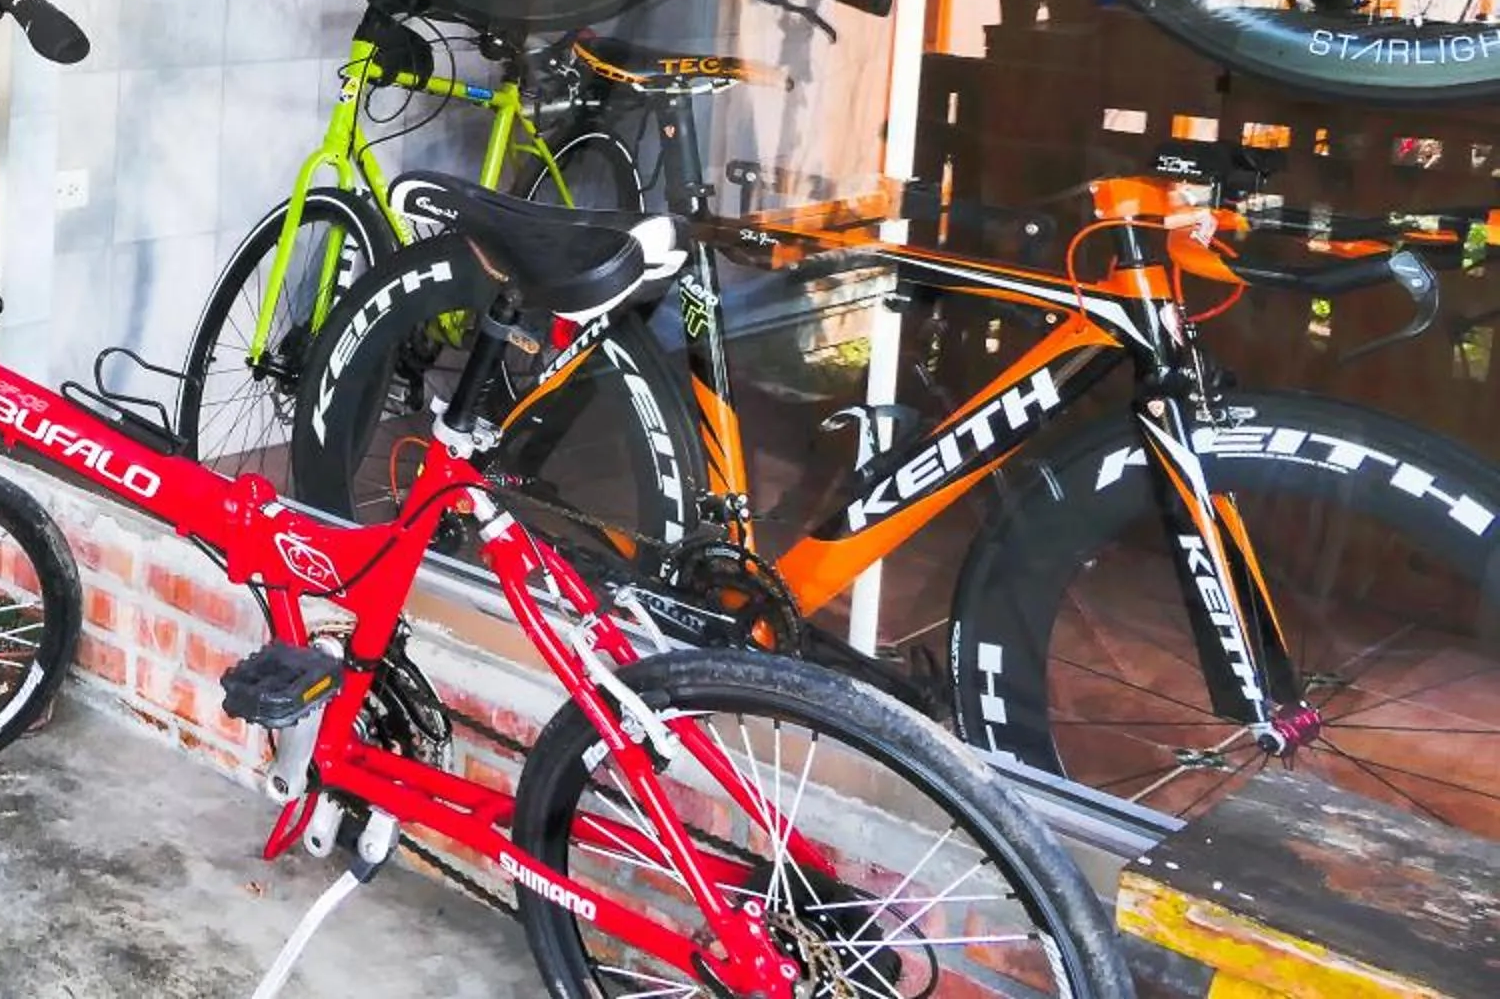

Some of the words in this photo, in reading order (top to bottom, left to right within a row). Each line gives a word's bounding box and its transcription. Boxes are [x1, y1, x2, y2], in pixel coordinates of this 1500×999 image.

[312, 260, 453, 448] KEITH
[847, 367, 1061, 533] KEITH
[1177, 535, 1264, 701] KEITH
[499, 851, 597, 922] SHIMANO
